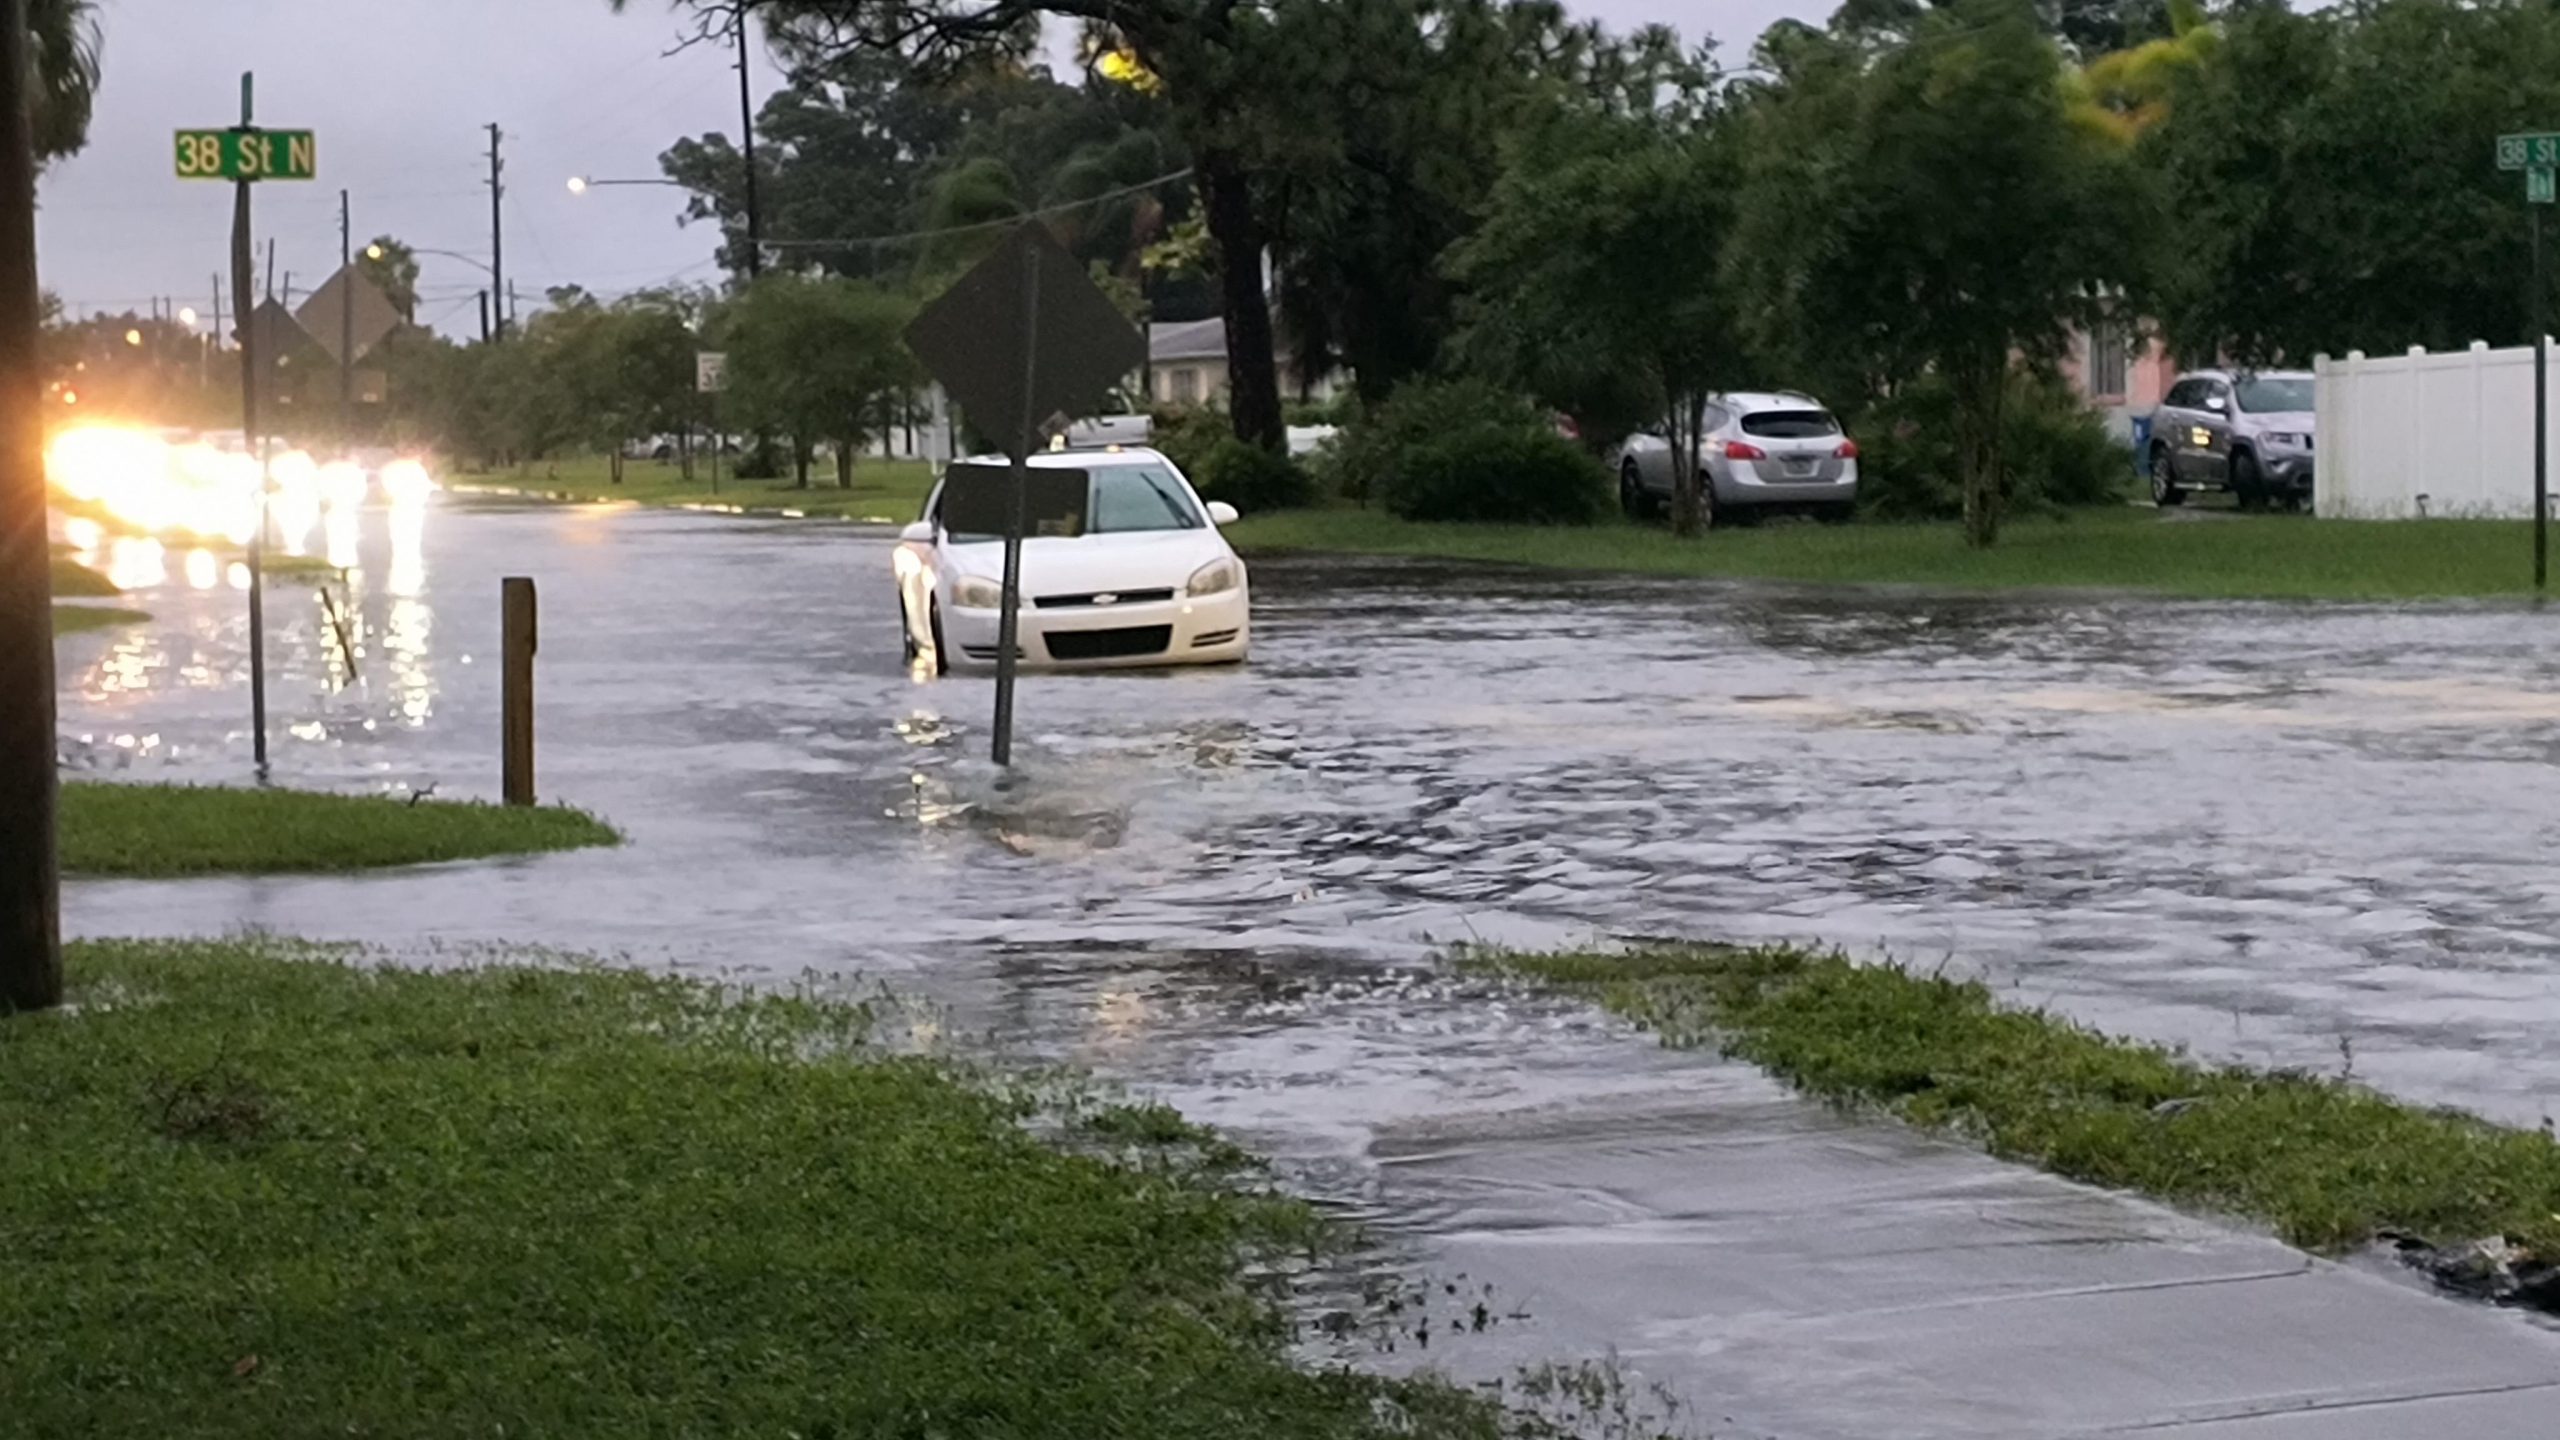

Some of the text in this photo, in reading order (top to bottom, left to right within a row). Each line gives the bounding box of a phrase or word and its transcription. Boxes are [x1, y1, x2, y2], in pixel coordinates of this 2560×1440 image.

[178, 133, 311, 174] 38 St N
[2501, 140, 2528, 165] 38
